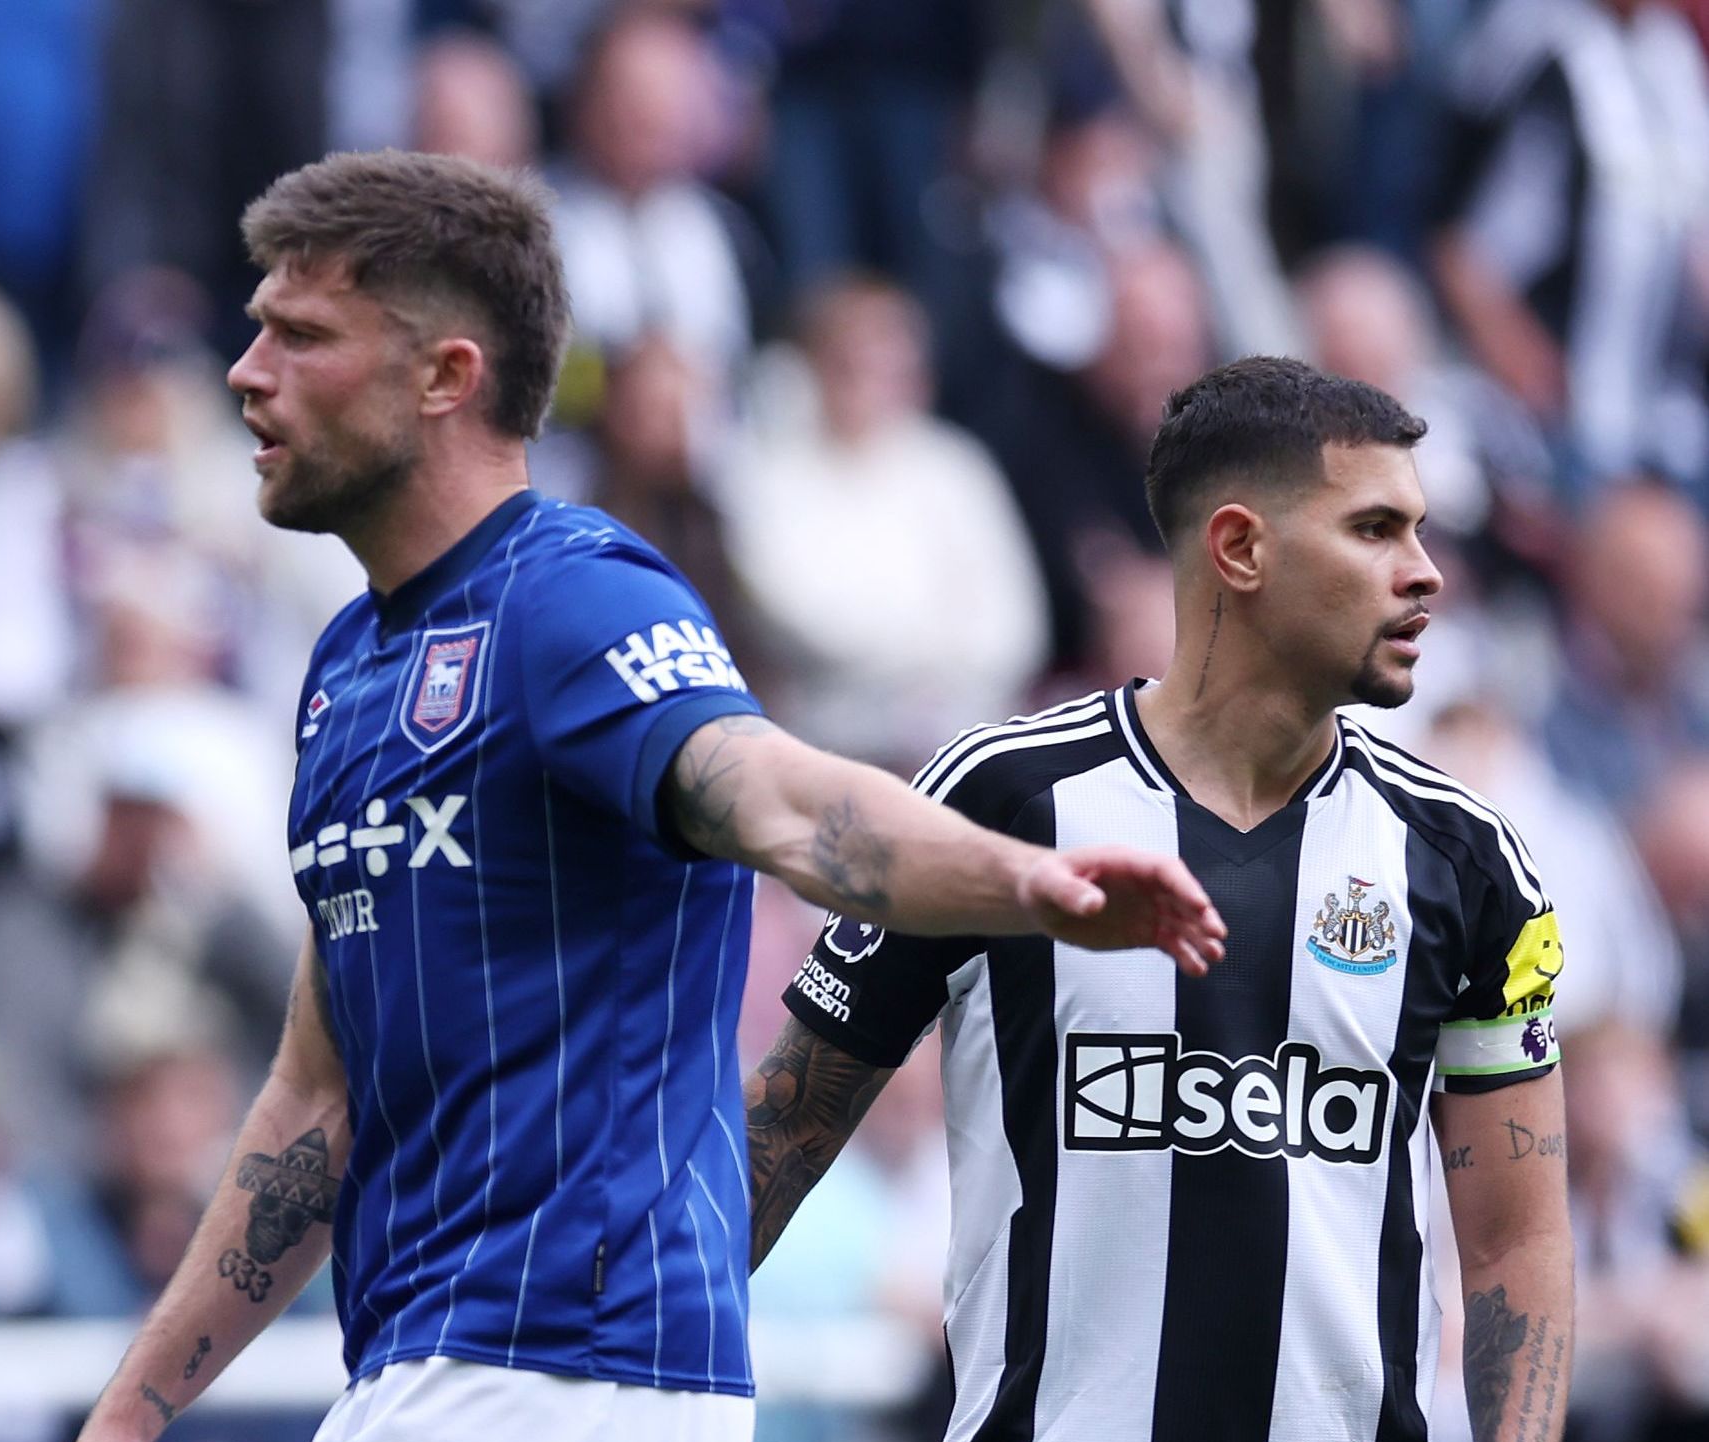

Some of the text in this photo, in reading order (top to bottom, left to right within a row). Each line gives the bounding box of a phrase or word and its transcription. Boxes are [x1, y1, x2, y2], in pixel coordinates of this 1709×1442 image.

[317, 888, 381, 941] TOUR
[797, 974, 851, 1022] racism
[808, 960, 850, 1002] room
[1173, 1055, 1380, 1154] sela
